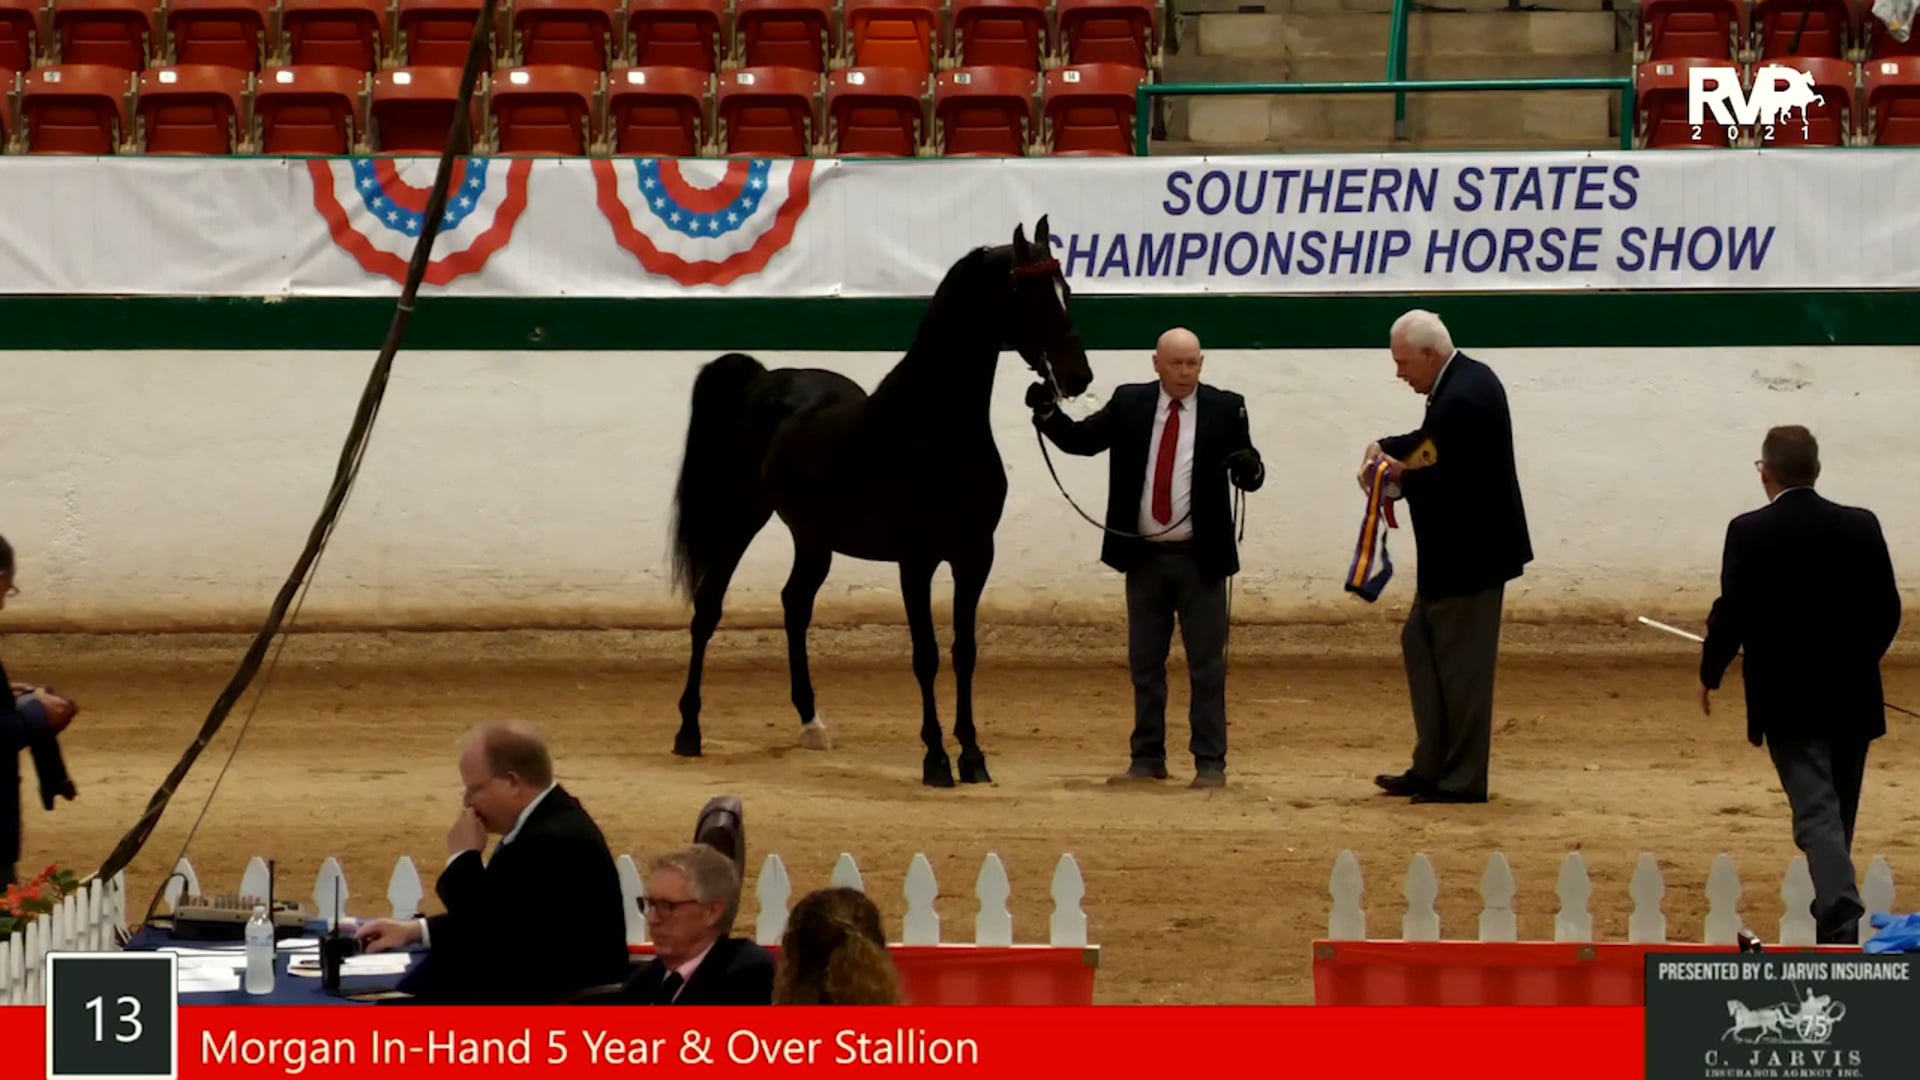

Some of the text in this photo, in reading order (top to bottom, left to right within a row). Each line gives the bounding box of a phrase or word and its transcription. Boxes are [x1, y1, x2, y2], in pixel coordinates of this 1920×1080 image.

[1162, 165, 1641, 216] SOUTHERN STATES
[1423, 228, 1603, 273] HORSE
[1616, 226, 1776, 272] SHOW
